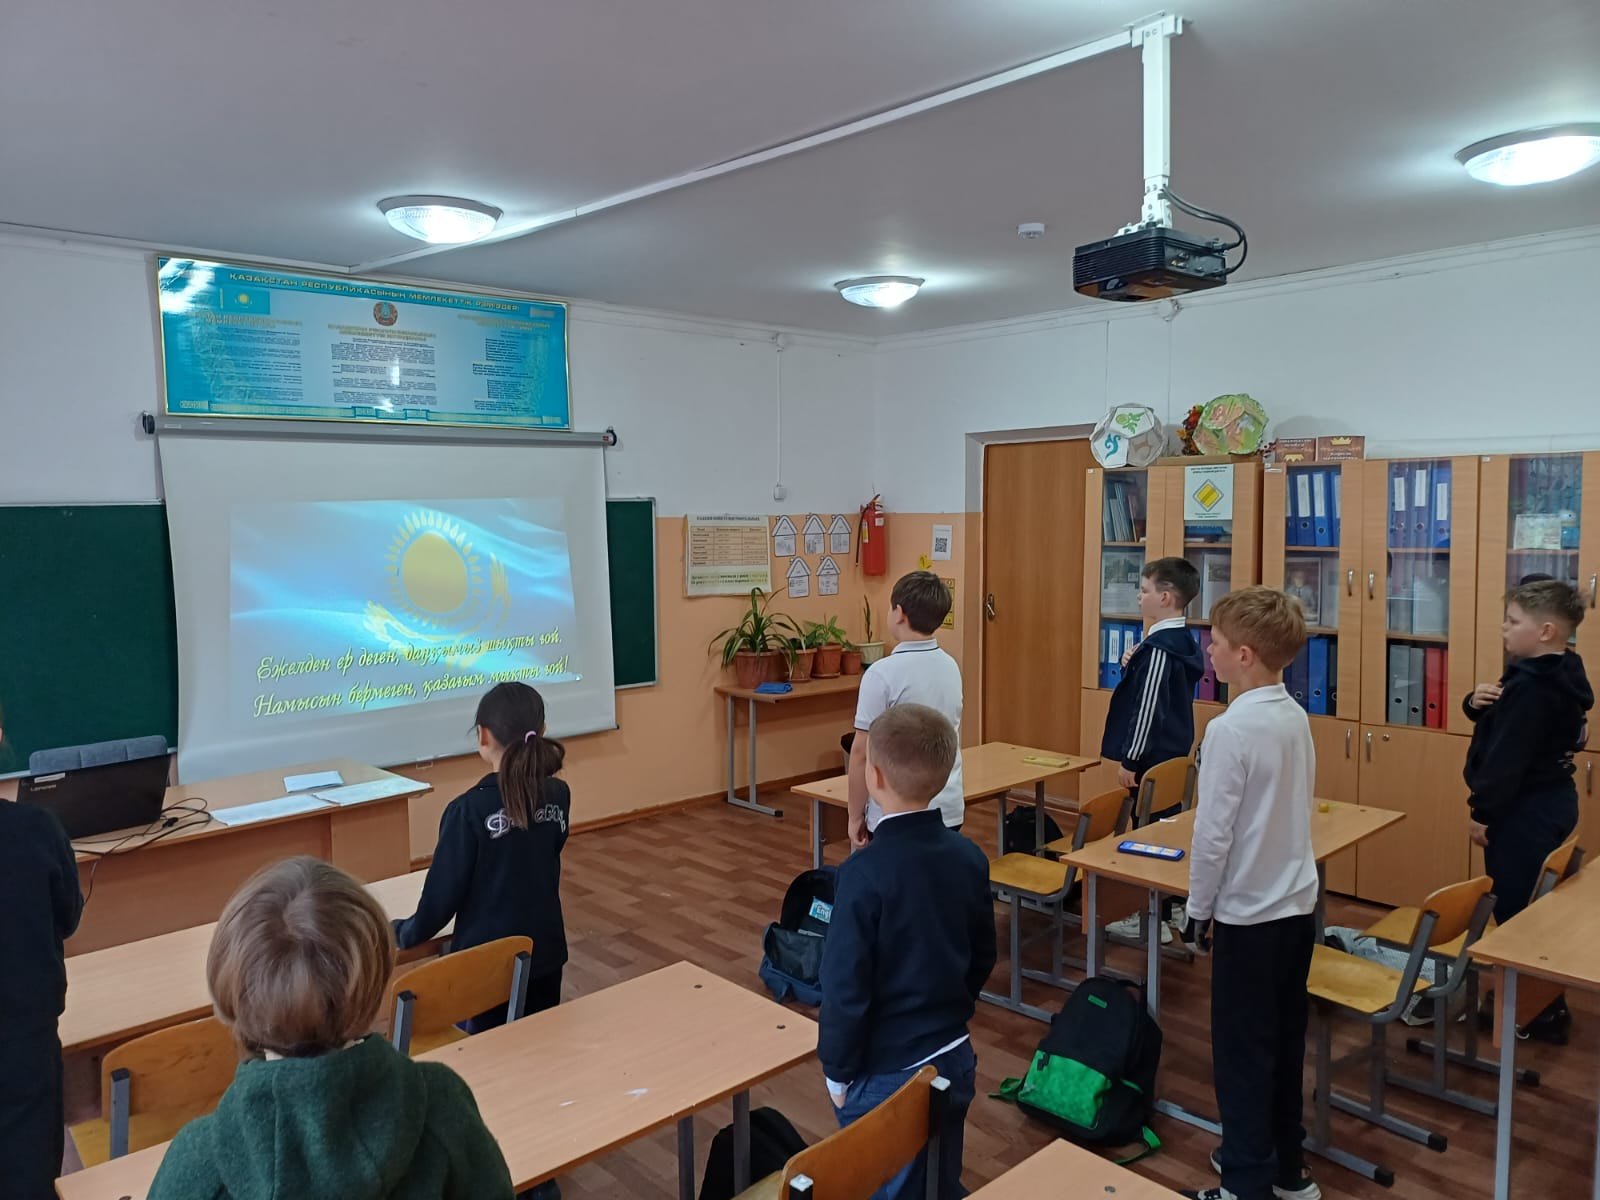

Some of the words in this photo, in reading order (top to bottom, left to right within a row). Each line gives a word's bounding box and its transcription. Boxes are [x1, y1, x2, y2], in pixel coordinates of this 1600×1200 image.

[256, 653, 331, 682] Ежелден
[336, 645, 354, 676] ер
[358, 648, 400, 666] деген,
[254, 692, 342, 718] Намысын
[348, 680, 417, 709] бермеген,
